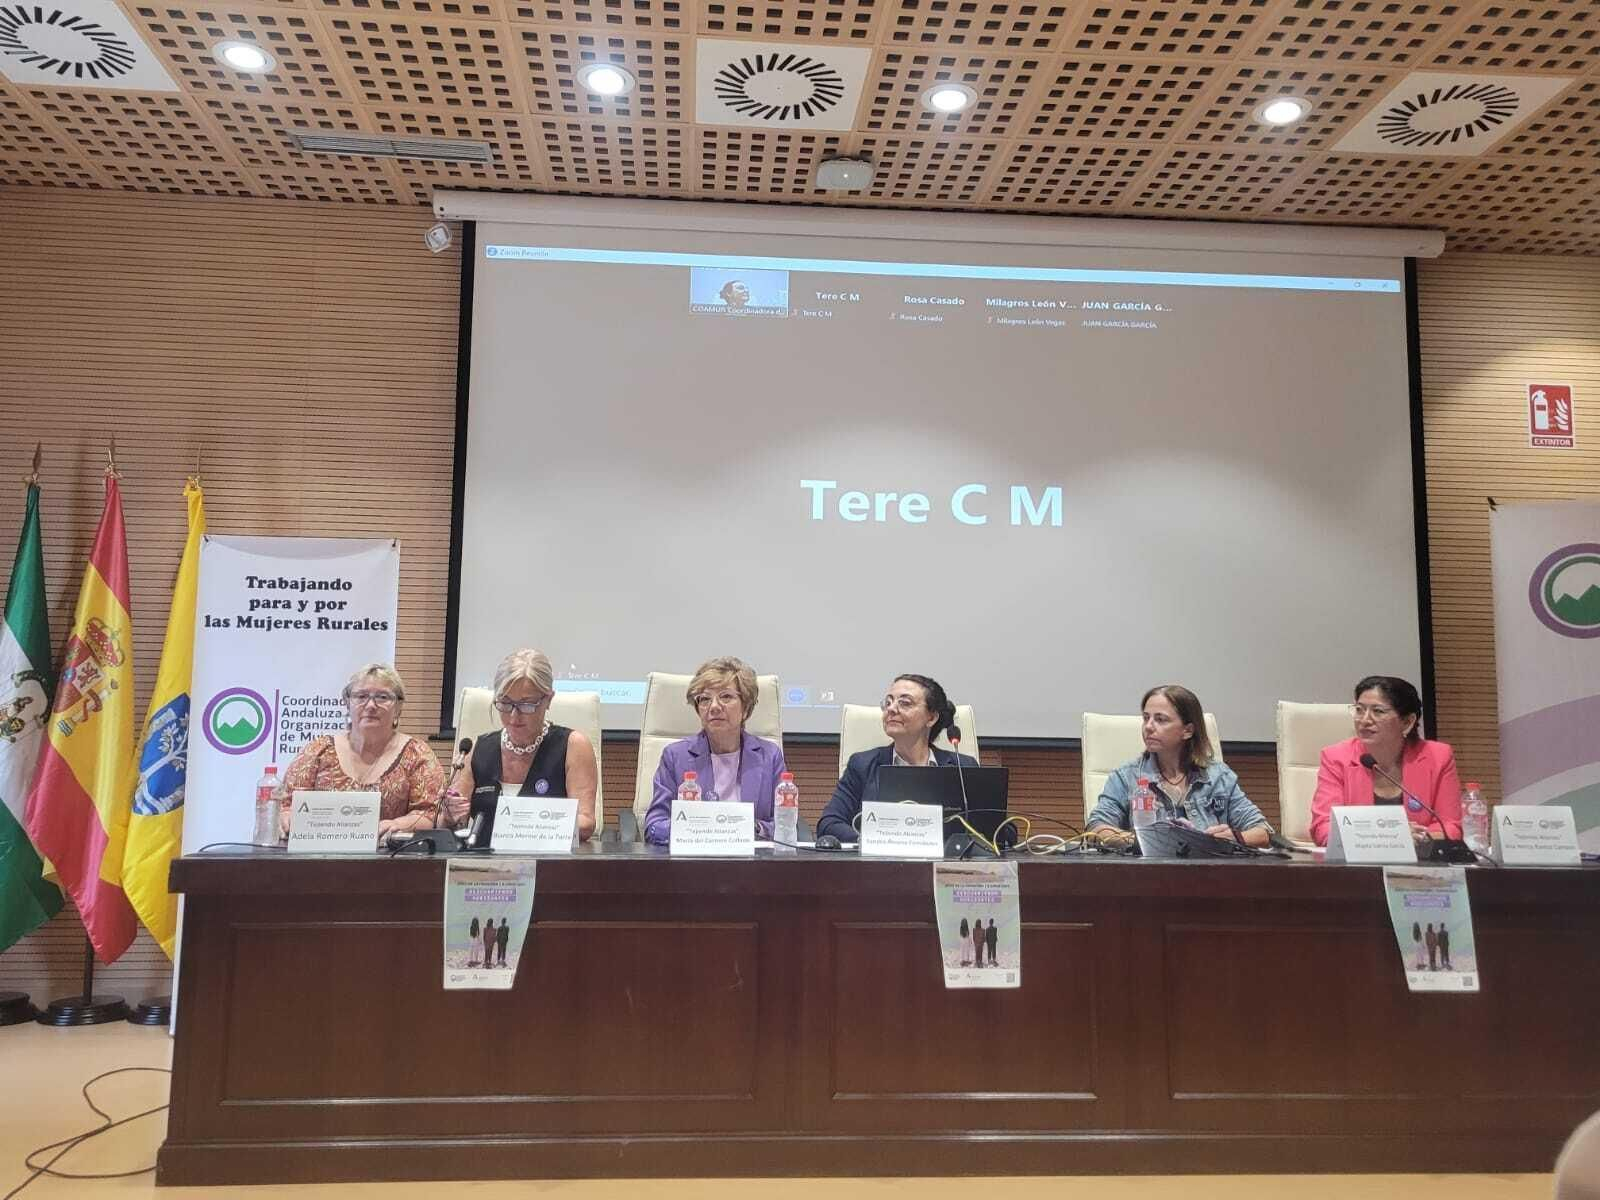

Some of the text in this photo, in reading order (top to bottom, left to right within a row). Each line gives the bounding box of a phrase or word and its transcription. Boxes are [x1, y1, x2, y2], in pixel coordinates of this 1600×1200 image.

[816, 292, 860, 301] Tere C M
[904, 295, 965, 306] Rosa Casado
[986, 298, 1029, 310] Milagros
[1032, 299, 1056, 309] León
[1082, 301, 1109, 310] JUAN
[1112, 301, 1151, 311] GARCÍA
[800, 479, 1063, 527] Tere C M
[246, 575, 353, 592] Trabajando
[249, 598, 347, 612] para y por
[204, 615, 388, 632] las Mujeres Rurales
[281, 707, 342, 718] Andaluza
[280, 732, 296, 742] de
[292, 832, 375, 840] Adela Romero Ruano
